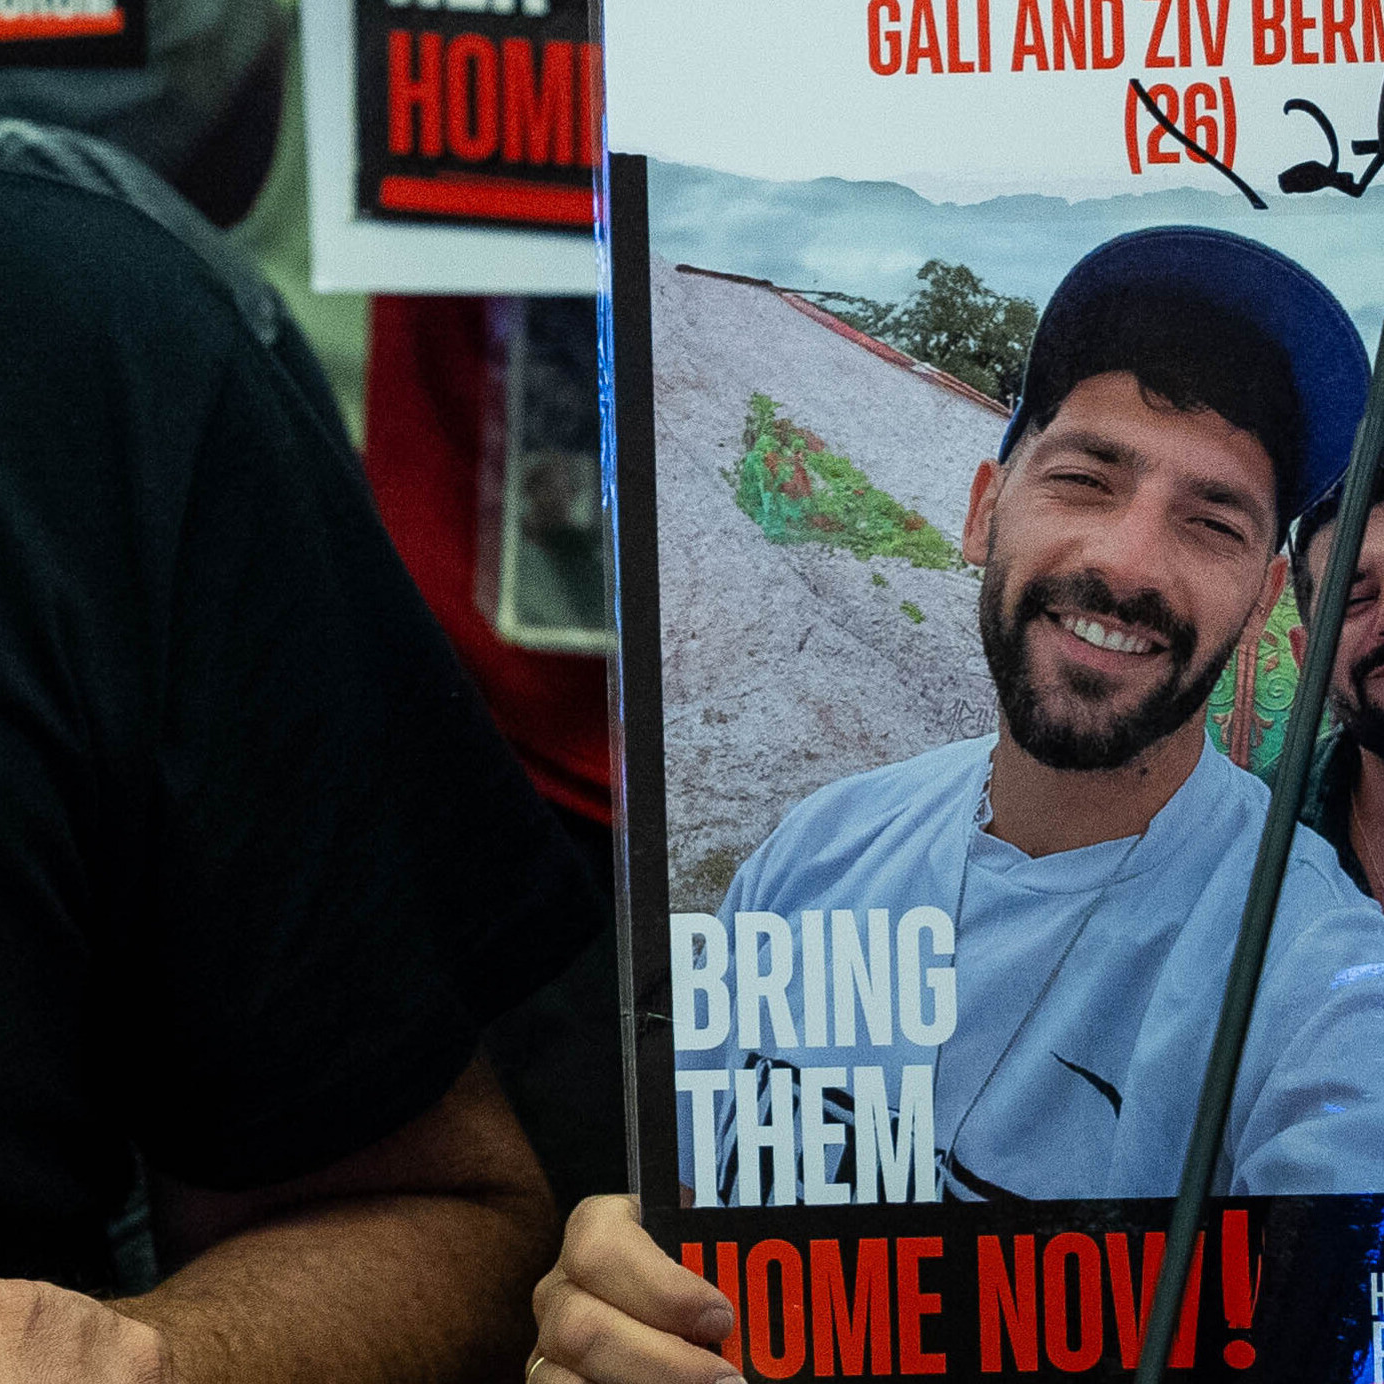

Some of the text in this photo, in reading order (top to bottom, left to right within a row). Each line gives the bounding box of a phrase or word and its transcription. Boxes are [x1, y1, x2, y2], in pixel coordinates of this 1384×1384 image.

[1124, 76, 1238, 176] (26)
[670, 905, 958, 1052] BRING
[675, 1065, 940, 1209] THEM
[977, 1209, 1265, 1373] NOW!
